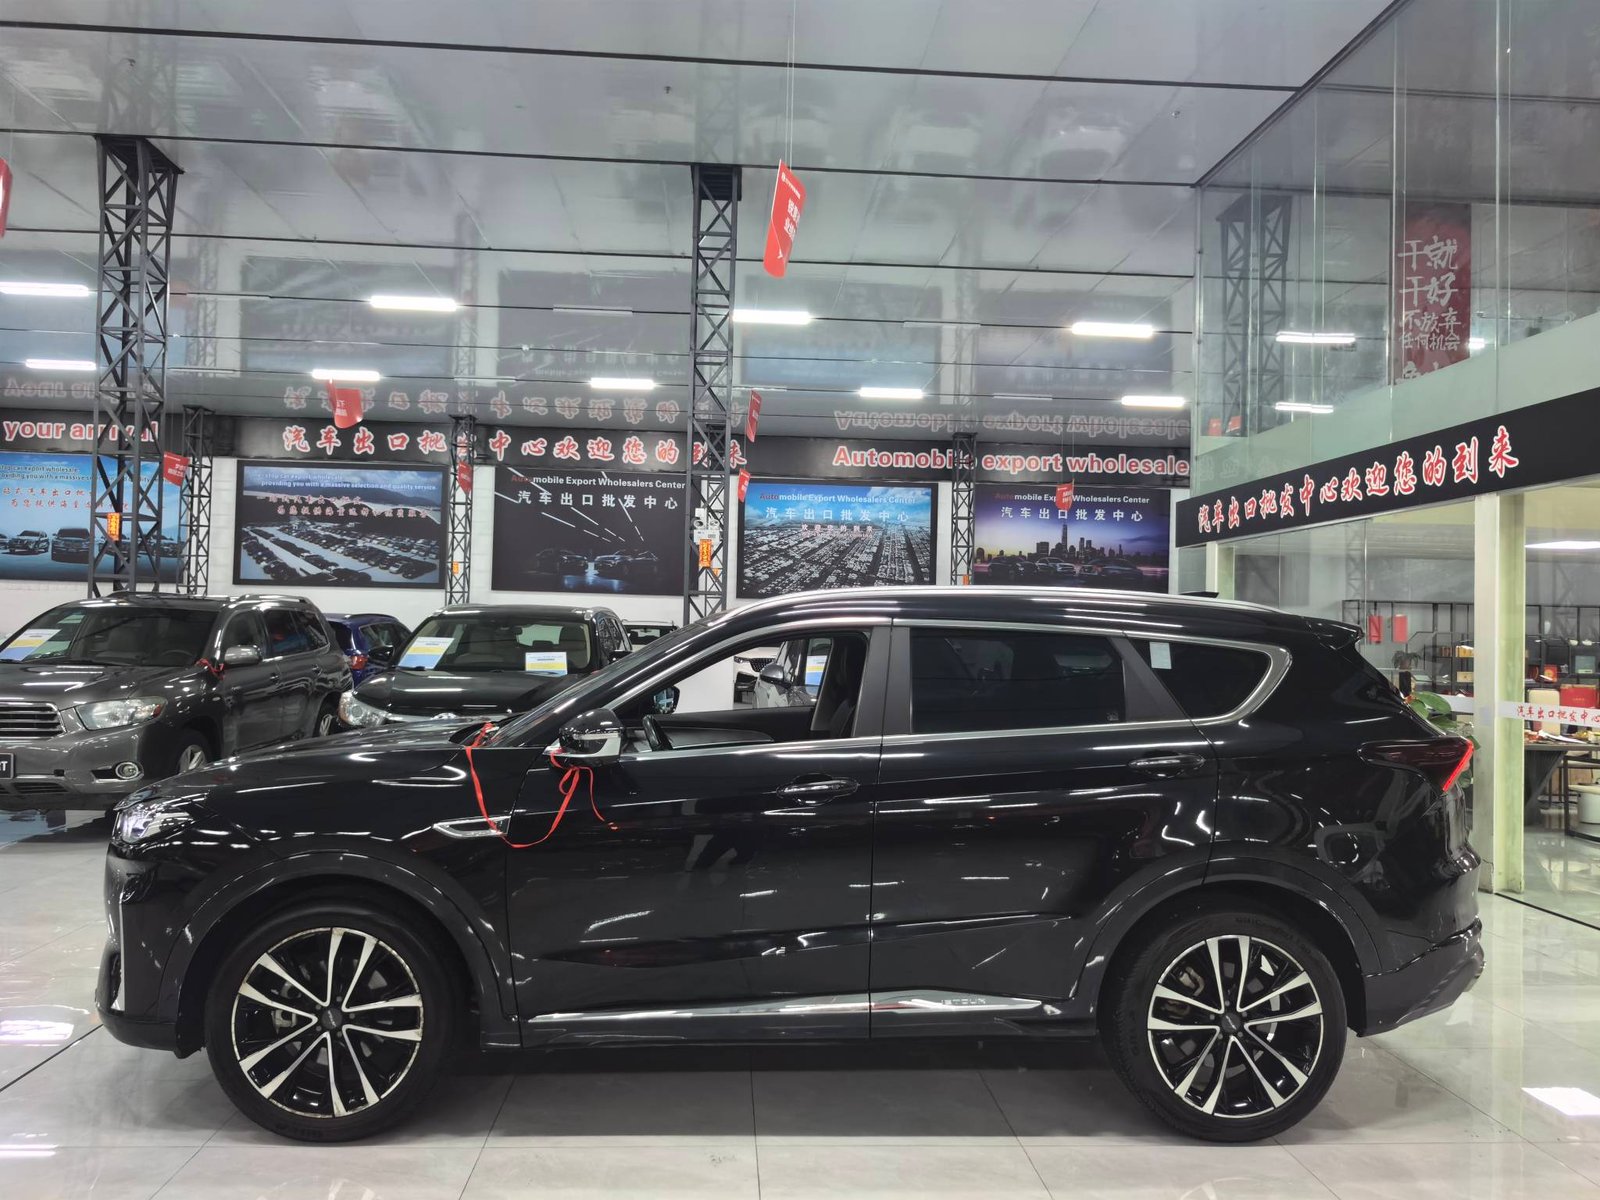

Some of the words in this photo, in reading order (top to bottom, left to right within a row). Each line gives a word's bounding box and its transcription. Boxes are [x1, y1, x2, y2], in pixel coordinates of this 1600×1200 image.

[3, 420, 66, 442] your
[982, 453, 1063, 475] export
[1066, 453, 1190, 476] wholesale
[261, 480, 292, 489] providing
[293, 481, 304, 489] you
[511, 475, 565, 485] Automobile
[566, 476, 597, 487] Export
[599, 478, 654, 488] Wholesalers
[655, 479, 686, 489] Center
[1198, 425, 1520, 534] 汽车出口批发中心欢迎您的到来
[517, 490, 679, 511] 汽车出口批发中心
[808, 494, 836, 504] Export
[837, 495, 888, 504] Wholesalers
[888, 496, 916, 504] Center
[1072, 495, 1122, 503] Wholesalers
[1122, 496, 1150, 504] Center
[765, 506, 910, 523] 汽车出口批发中心
[1001, 506, 1144, 523] 汽车出口批发中心
